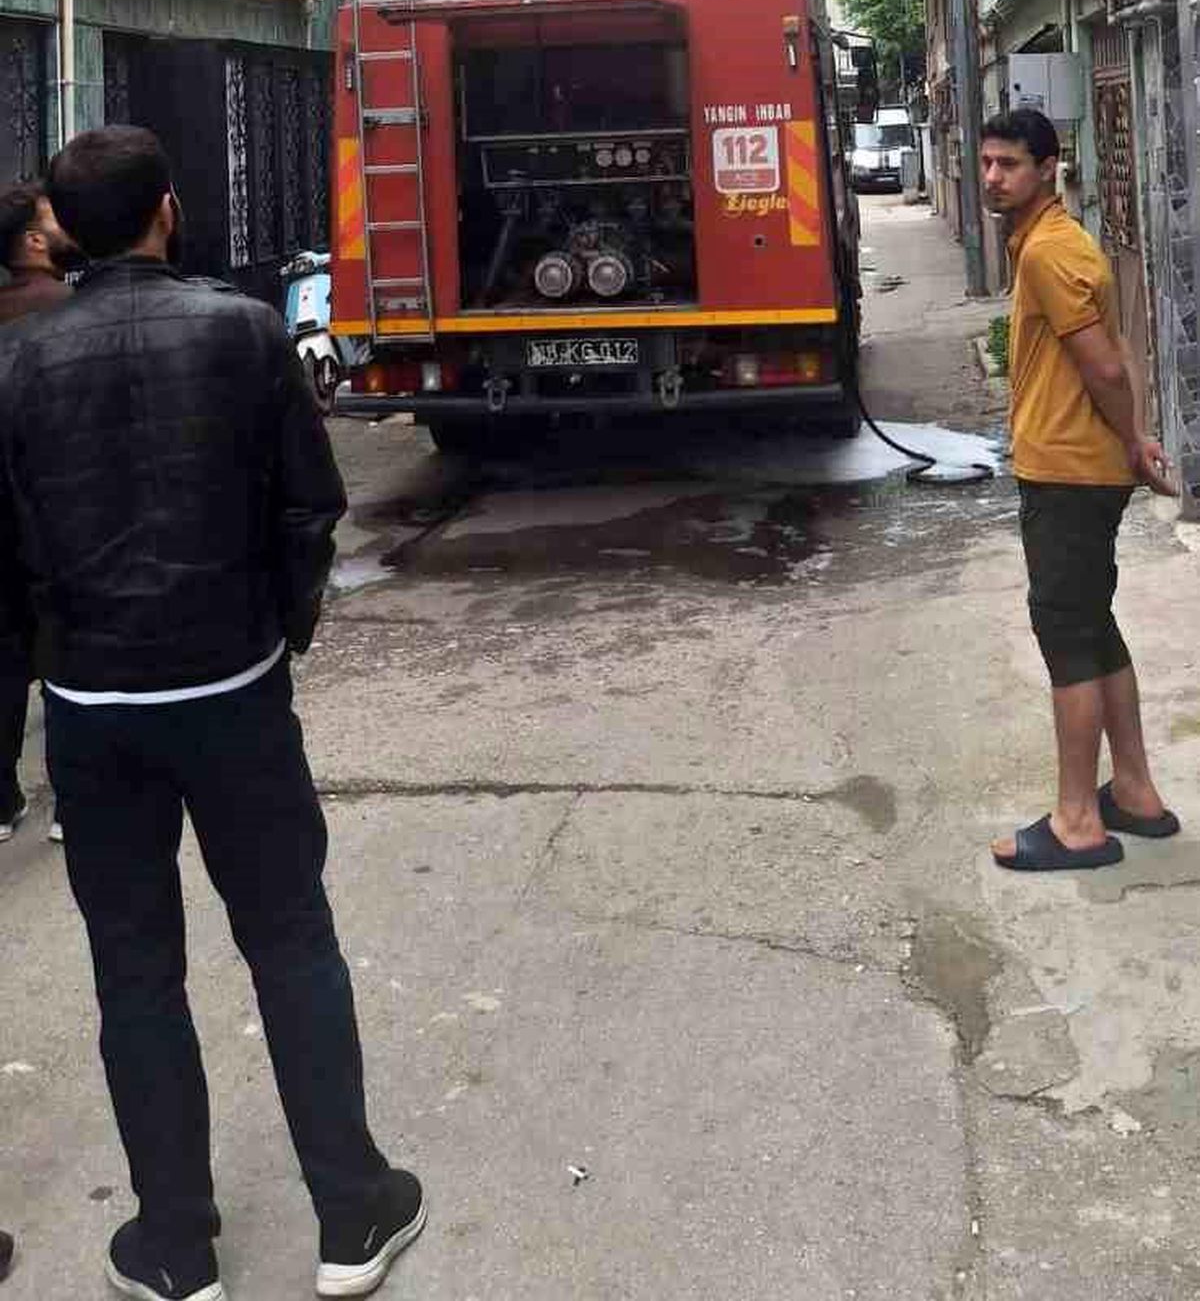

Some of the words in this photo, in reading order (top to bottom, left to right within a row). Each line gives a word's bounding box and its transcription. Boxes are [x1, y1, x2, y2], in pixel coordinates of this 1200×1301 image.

[704, 104, 747, 124] YANGIN
[722, 134, 769, 165] 112
[724, 194, 788, 216] Ziegle
